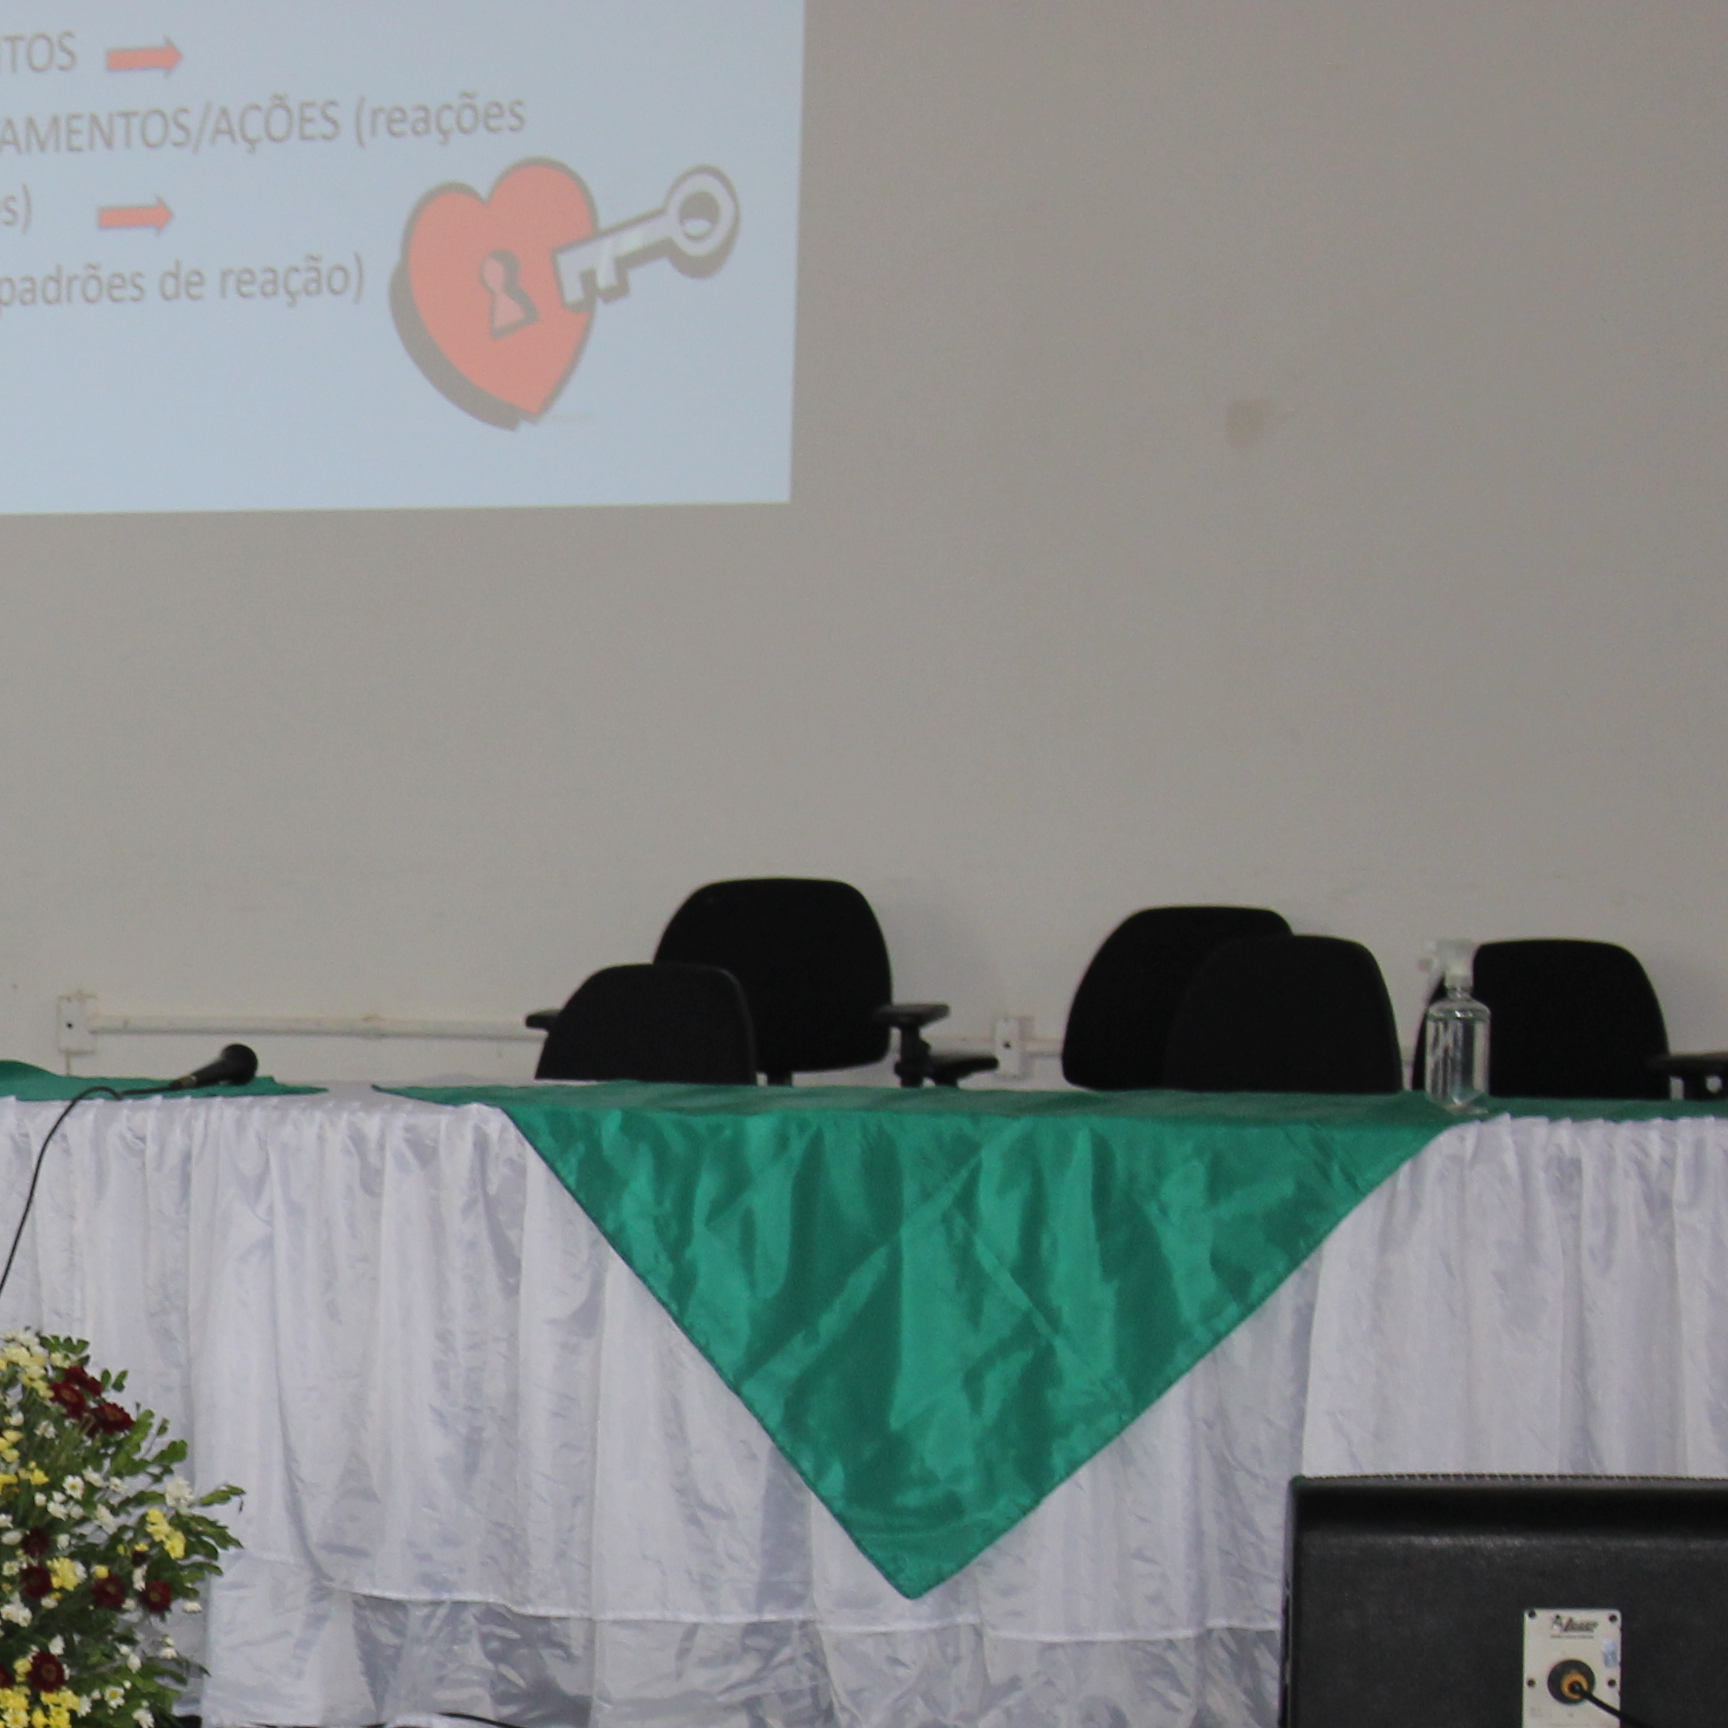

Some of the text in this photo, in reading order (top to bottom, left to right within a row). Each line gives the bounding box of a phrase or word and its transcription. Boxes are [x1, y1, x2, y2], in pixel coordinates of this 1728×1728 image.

[355, 90, 526, 148] (reações
[159, 259, 206, 301] de
[219, 251, 364, 308] reação)
